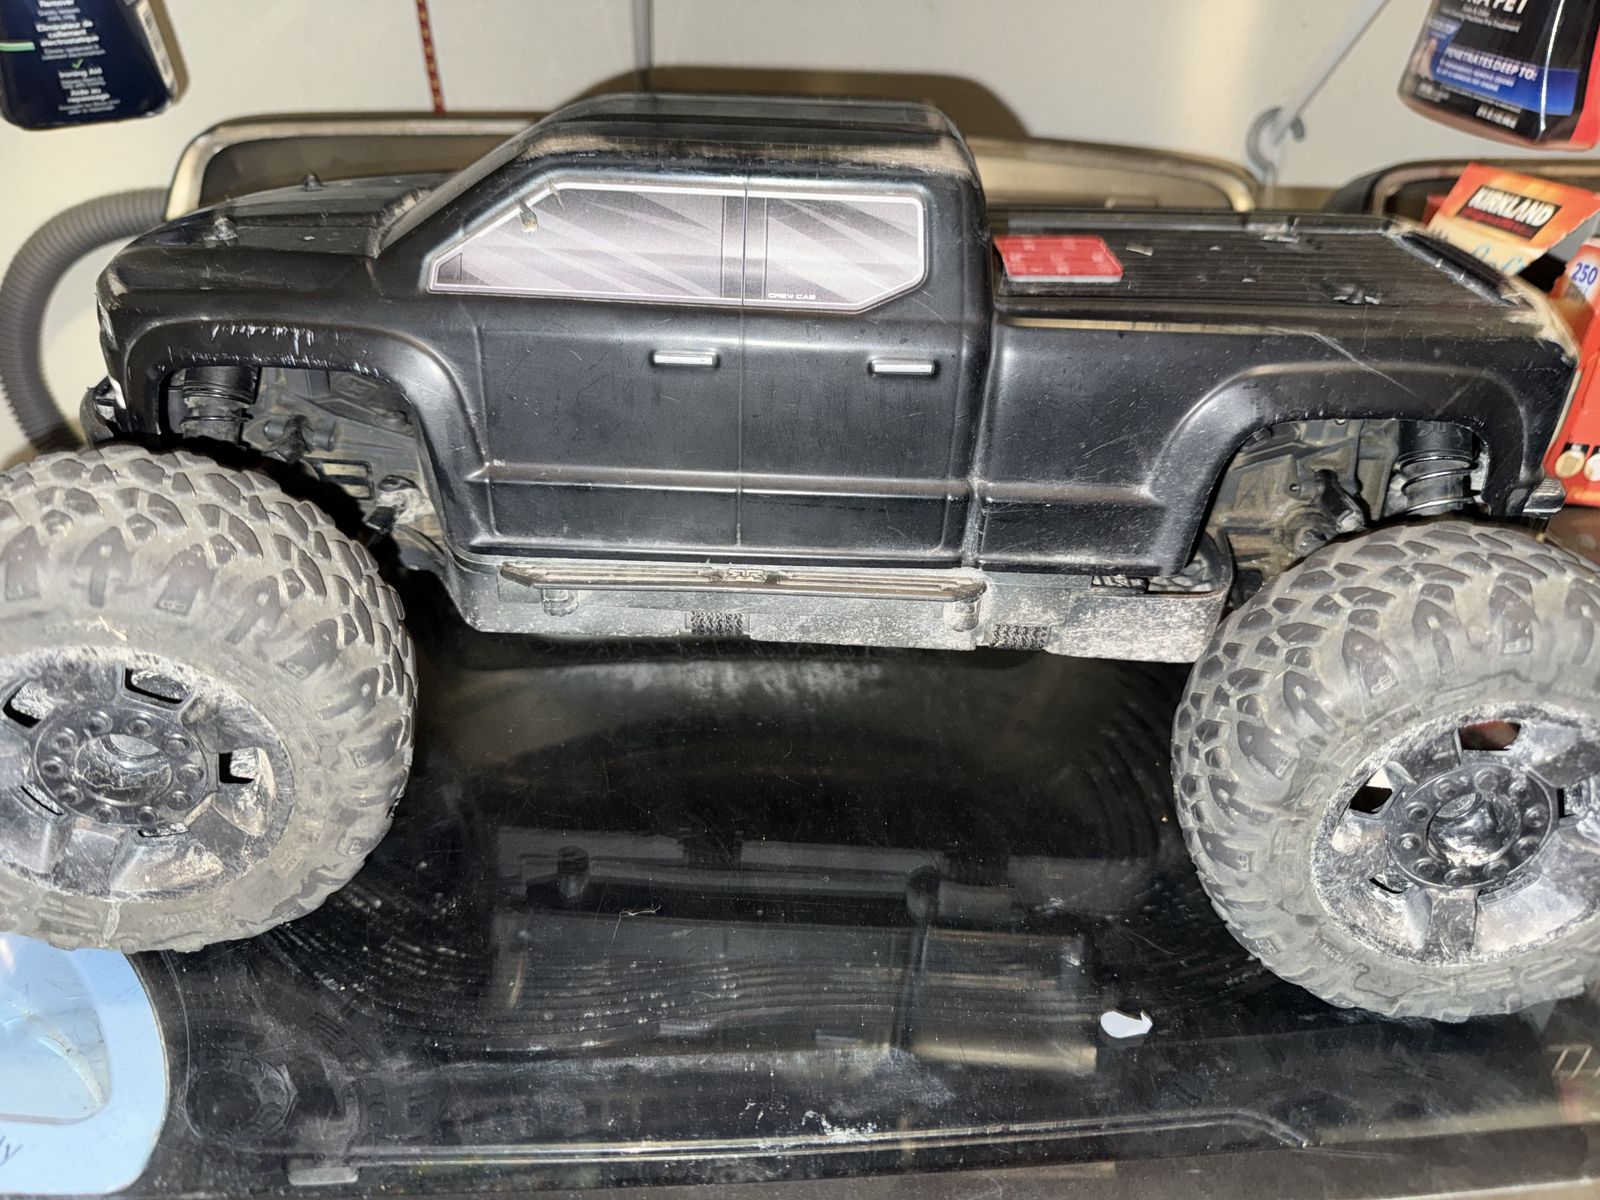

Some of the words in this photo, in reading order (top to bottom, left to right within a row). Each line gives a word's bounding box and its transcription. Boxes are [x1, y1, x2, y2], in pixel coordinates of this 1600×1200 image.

[58, 70, 88, 78] Ironing
[88, 67, 103, 76] Aid
[1492, 58, 1521, 76] DEEP
[1518, 64, 1539, 82] TO:
[1467, 186, 1556, 228] KIRKLAND
[1570, 261, 1599, 286] 250
